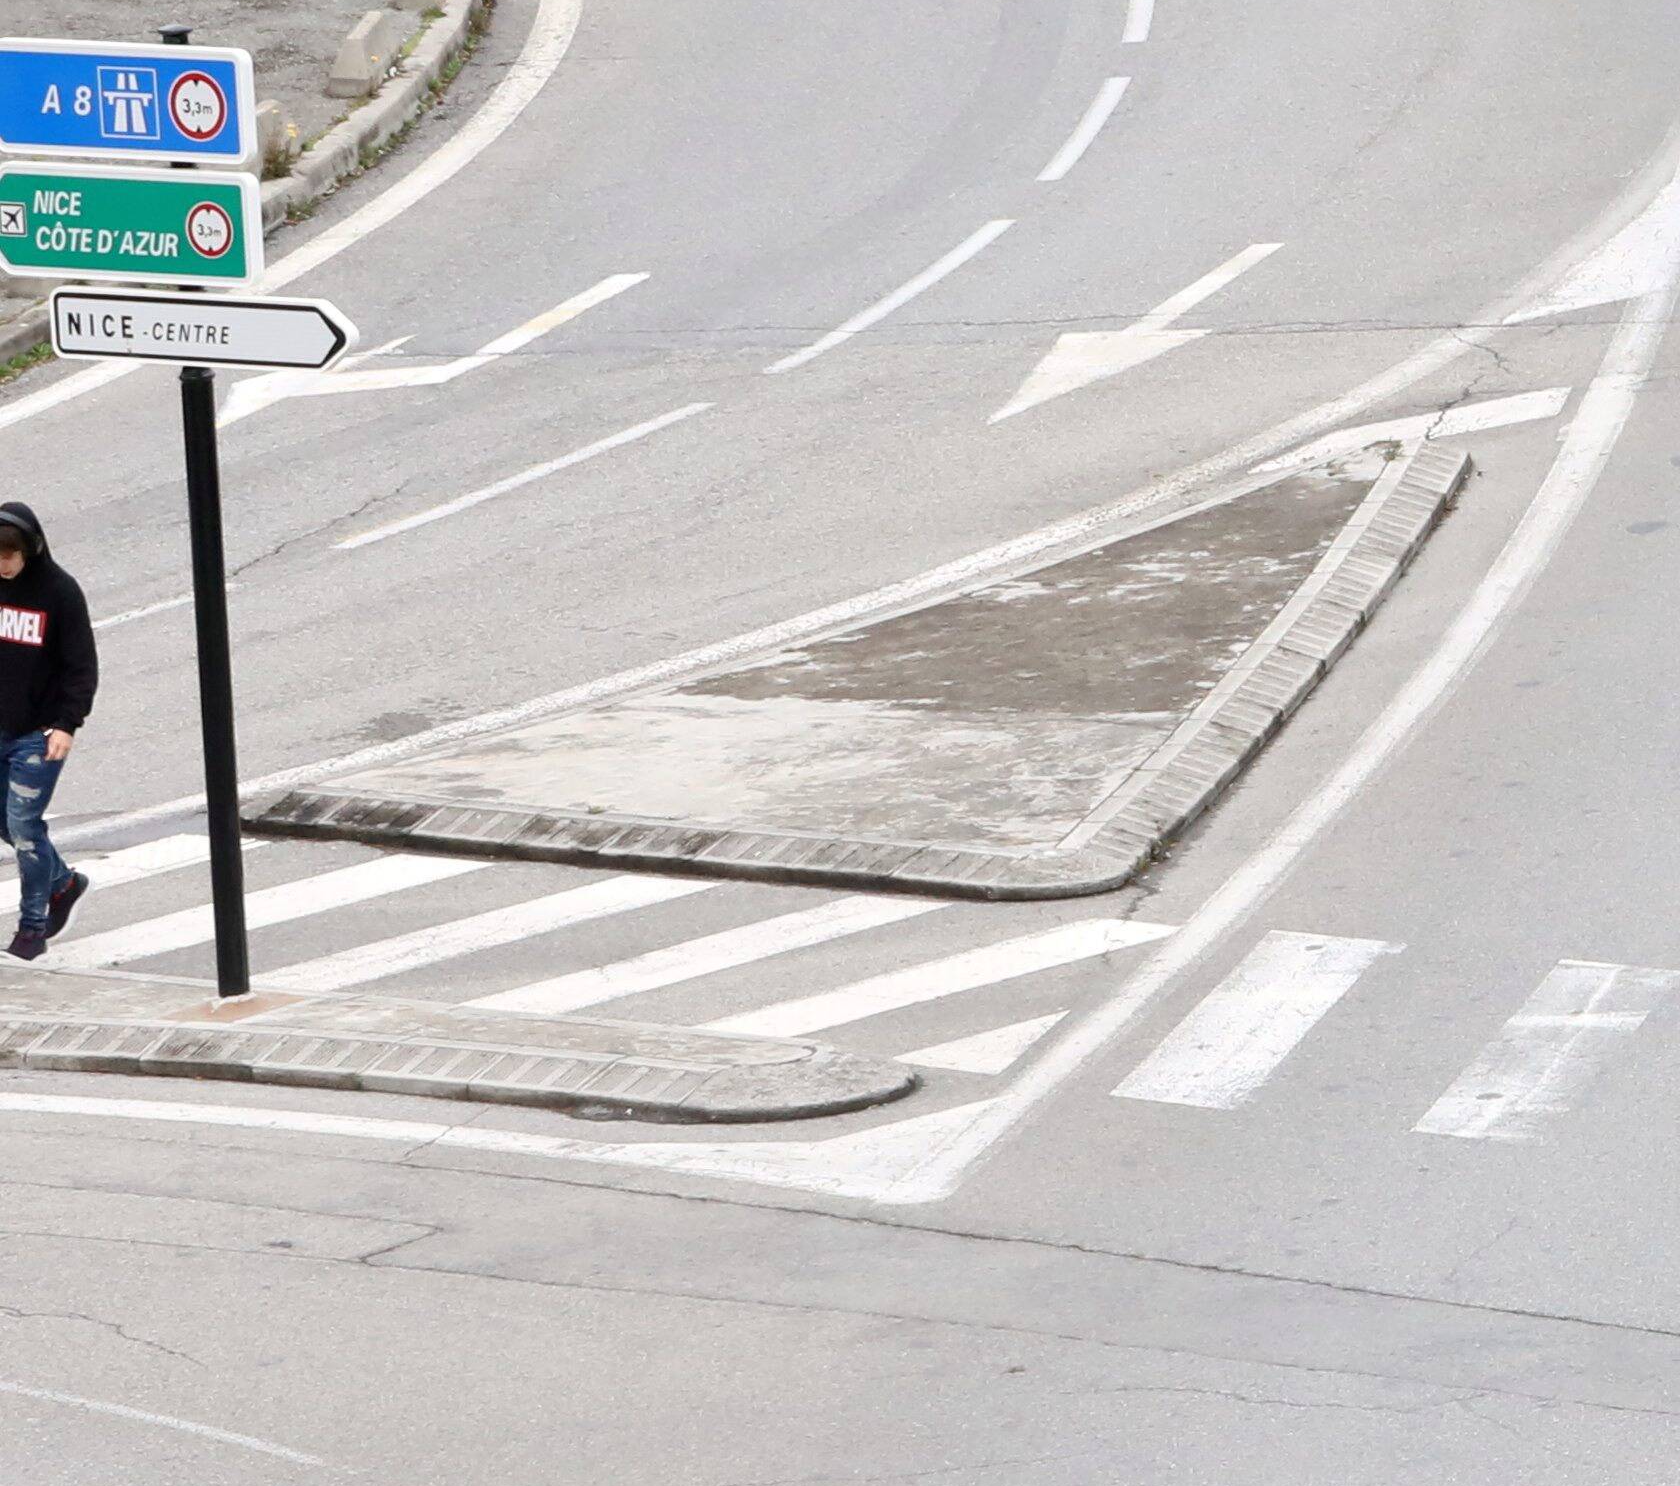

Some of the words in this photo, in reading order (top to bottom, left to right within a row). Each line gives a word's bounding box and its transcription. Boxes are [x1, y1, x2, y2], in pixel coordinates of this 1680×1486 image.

[41, 84, 61, 115] A
[73, 85, 92, 116] 8
[182, 98, 213, 117] 3,3m
[33, 190, 81, 216] NICE
[36, 222, 92, 253] CÔTE
[97, 225, 179, 257] D'AZUR
[66, 312, 134, 340] NICE
[0, 606, 42, 644] RVEL
